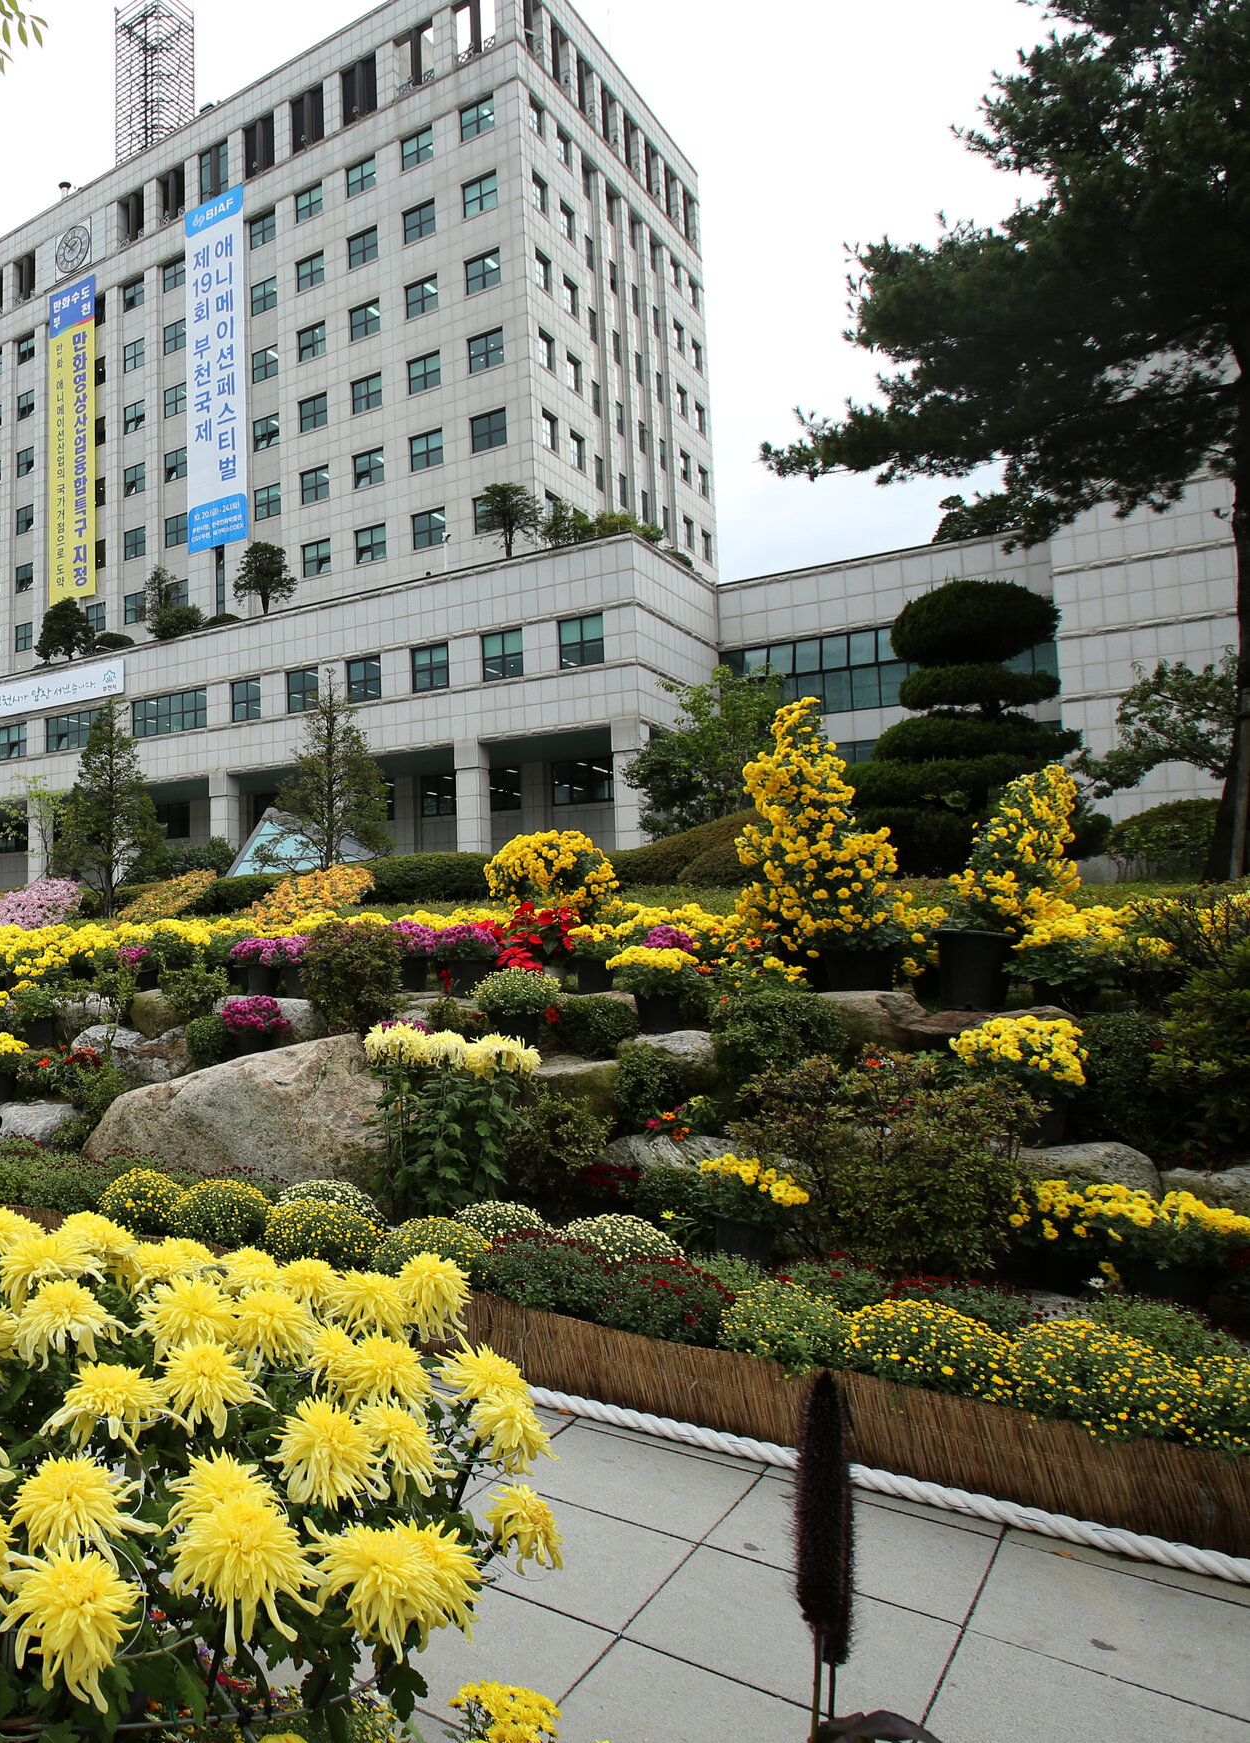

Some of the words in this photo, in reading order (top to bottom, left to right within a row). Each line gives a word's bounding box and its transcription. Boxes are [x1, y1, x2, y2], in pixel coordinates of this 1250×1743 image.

[205, 197, 235, 221] BIAF
[53, 285, 90, 314] 만화수도
[192, 244, 212, 324] 제19회
[193, 334, 213, 442] 부천국제
[215, 233, 237, 482] 애니메이션페스티벌
[72, 331, 88, 538] 만화영상산업융합특구
[72, 544, 88, 587] 지정
[31, 686, 52, 702] 앞장
